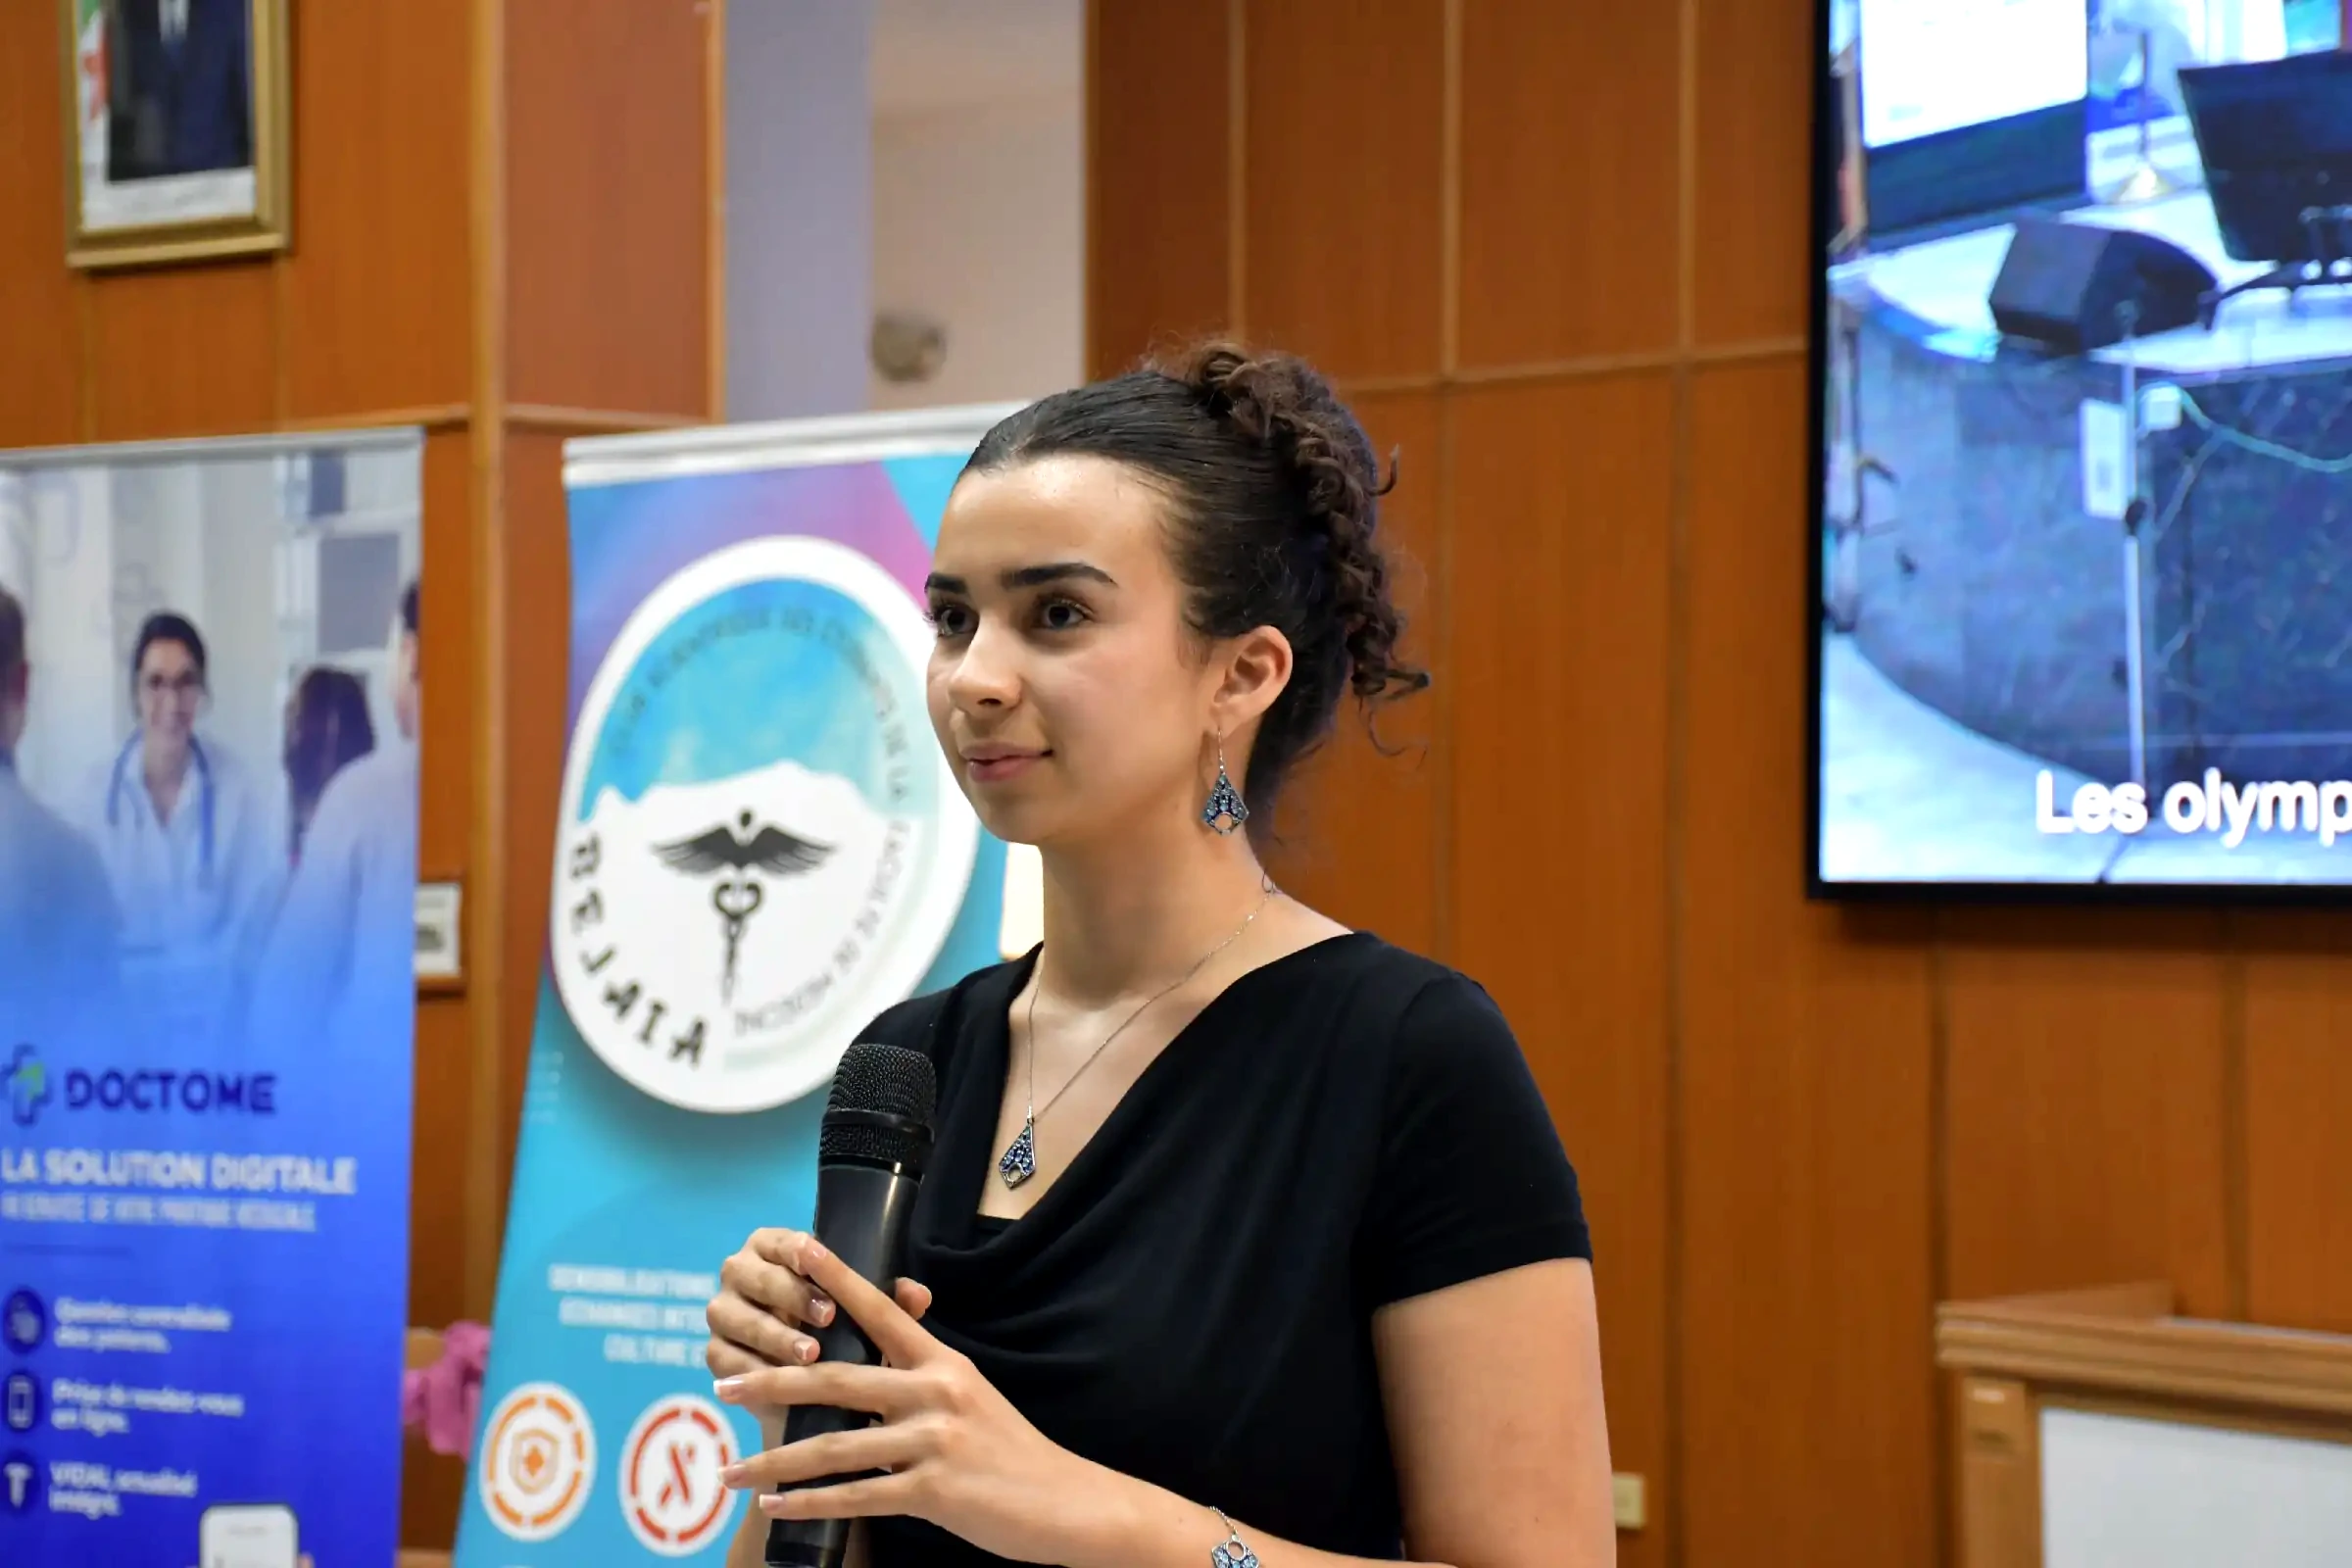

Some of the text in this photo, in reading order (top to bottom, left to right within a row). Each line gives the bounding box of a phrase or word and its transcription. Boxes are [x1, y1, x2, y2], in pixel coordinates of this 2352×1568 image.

[2035, 768, 2148, 834] Les
[66, 1070, 275, 1114] DOCTOME
[1, 1150, 357, 1196] LA SOLUTION DIGITALE
